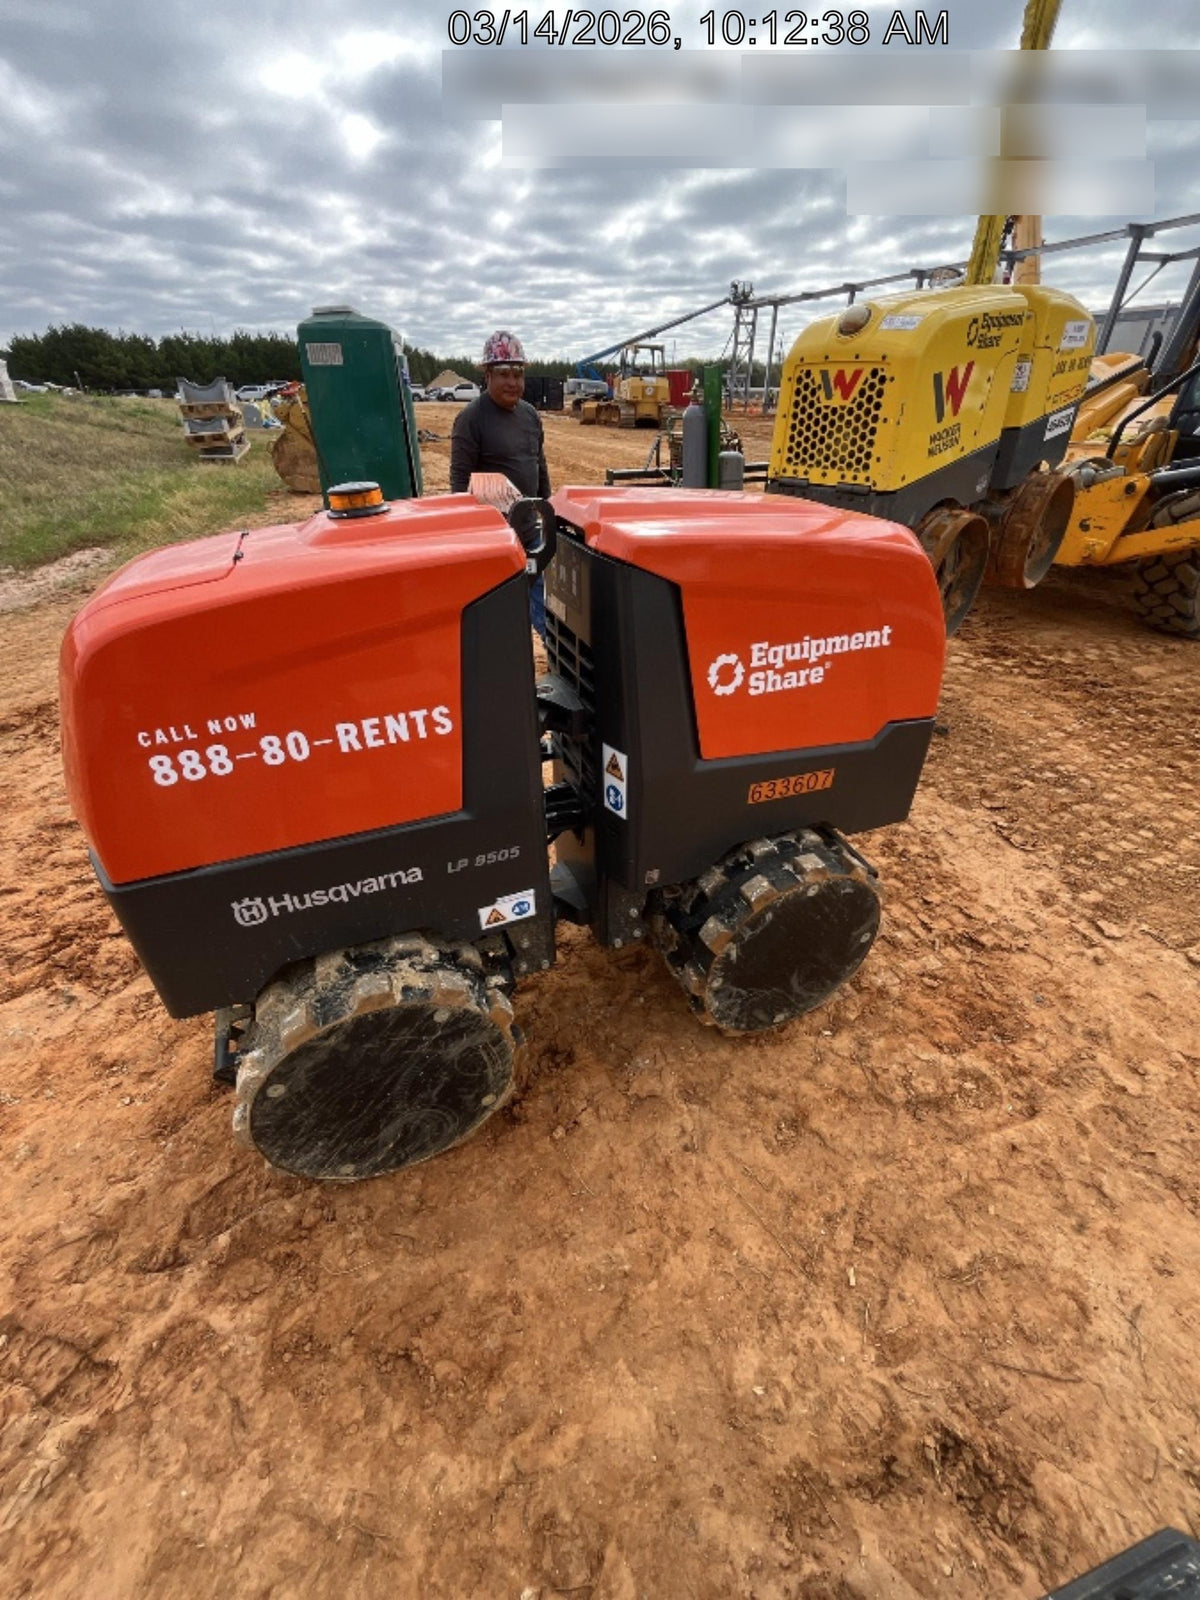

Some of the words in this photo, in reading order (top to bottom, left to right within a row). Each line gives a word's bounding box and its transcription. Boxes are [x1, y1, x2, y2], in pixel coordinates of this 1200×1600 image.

[749, 624, 893, 669] Equipment
[748, 665, 825, 697] Share
[137, 724, 198, 748] CALL
[206, 711, 257, 735] NOW
[148, 704, 453, 787] 888-80-RENTS
[750, 770, 832, 803] 633607
[446, 857, 469, 874] LP
[268, 866, 424, 917] Husqvarna
